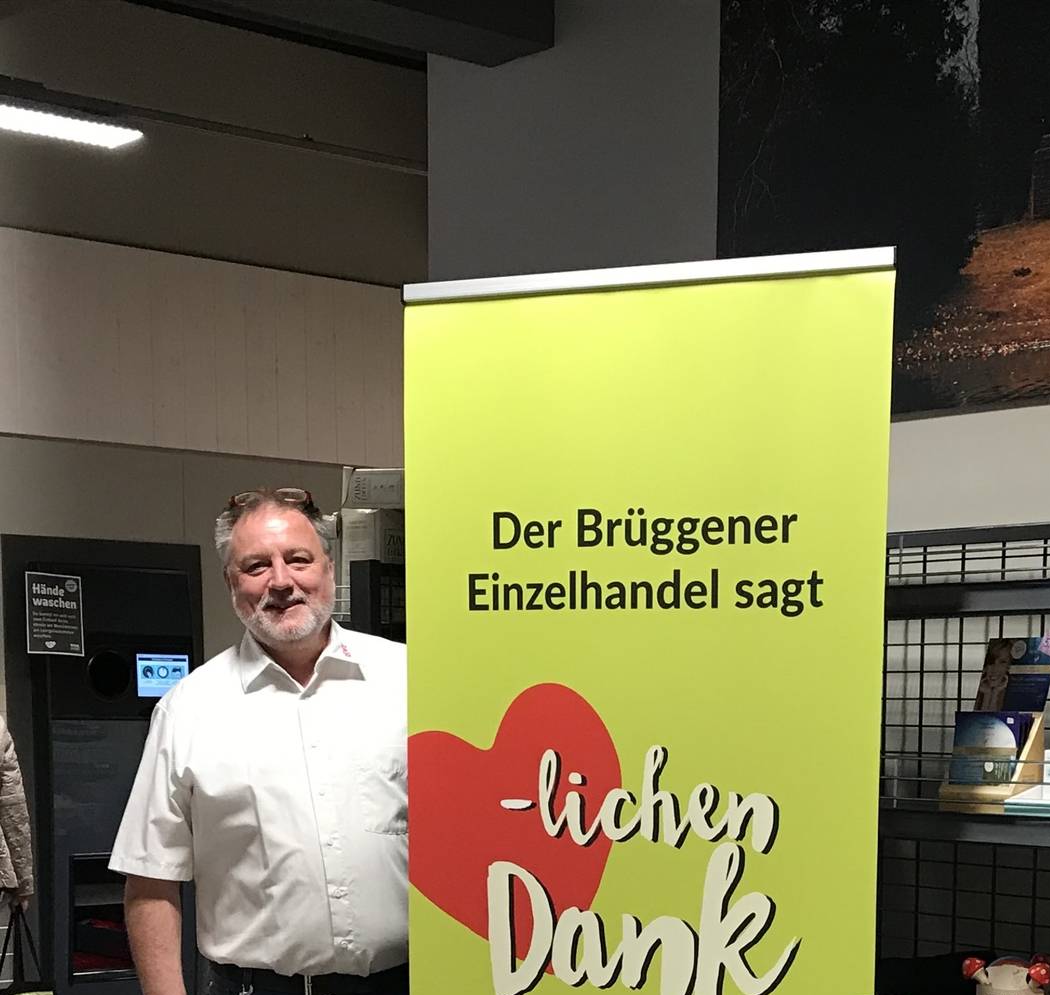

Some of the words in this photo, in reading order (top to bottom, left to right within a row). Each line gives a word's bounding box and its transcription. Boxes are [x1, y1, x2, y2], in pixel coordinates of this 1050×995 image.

[492, 510, 562, 550] Der
[576, 508, 798, 556] Brüggener
[32, 583, 65, 597] Hände
[32, 597, 77, 609] waschen
[468, 569, 720, 611] Einzelhandel
[734, 570, 824, 617] sagt
[500, 744, 780, 854] -lichen
